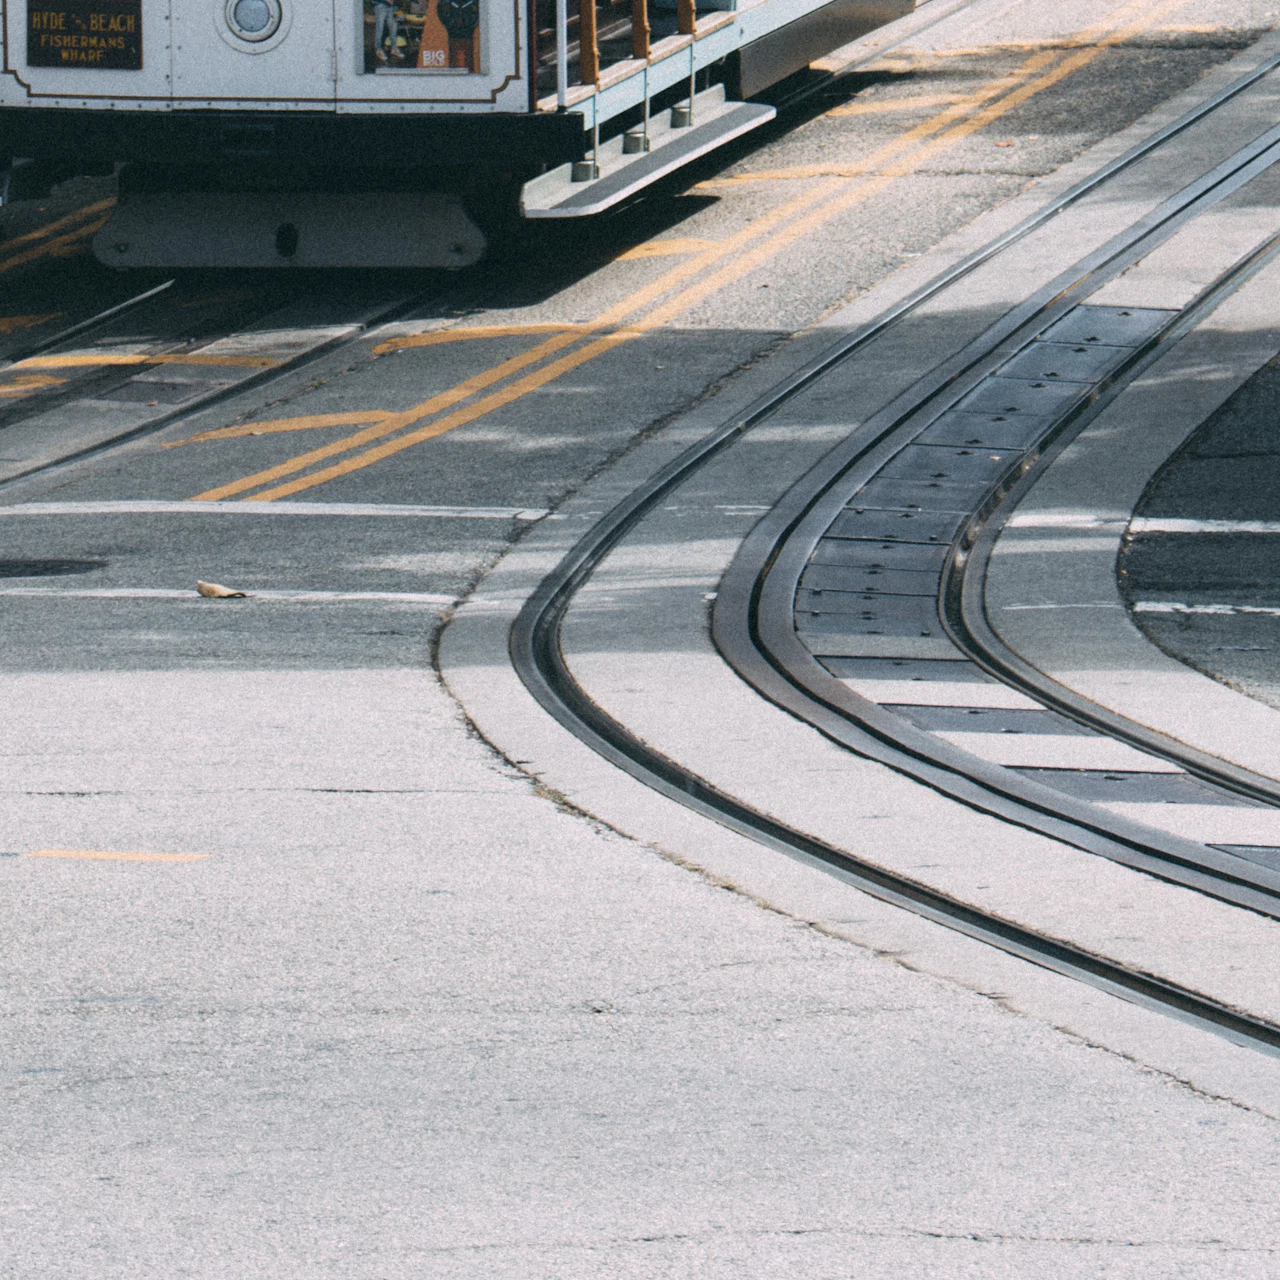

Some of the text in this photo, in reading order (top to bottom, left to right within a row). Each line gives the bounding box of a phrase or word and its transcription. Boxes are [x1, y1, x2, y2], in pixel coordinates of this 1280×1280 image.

[31, 11, 67, 31] HYDE
[89, 13, 136, 33] BEACH
[40, 34, 126, 49] FISHERMANS
[60, 48, 105, 62] WHARF
[422, 50, 446, 61] BIG
